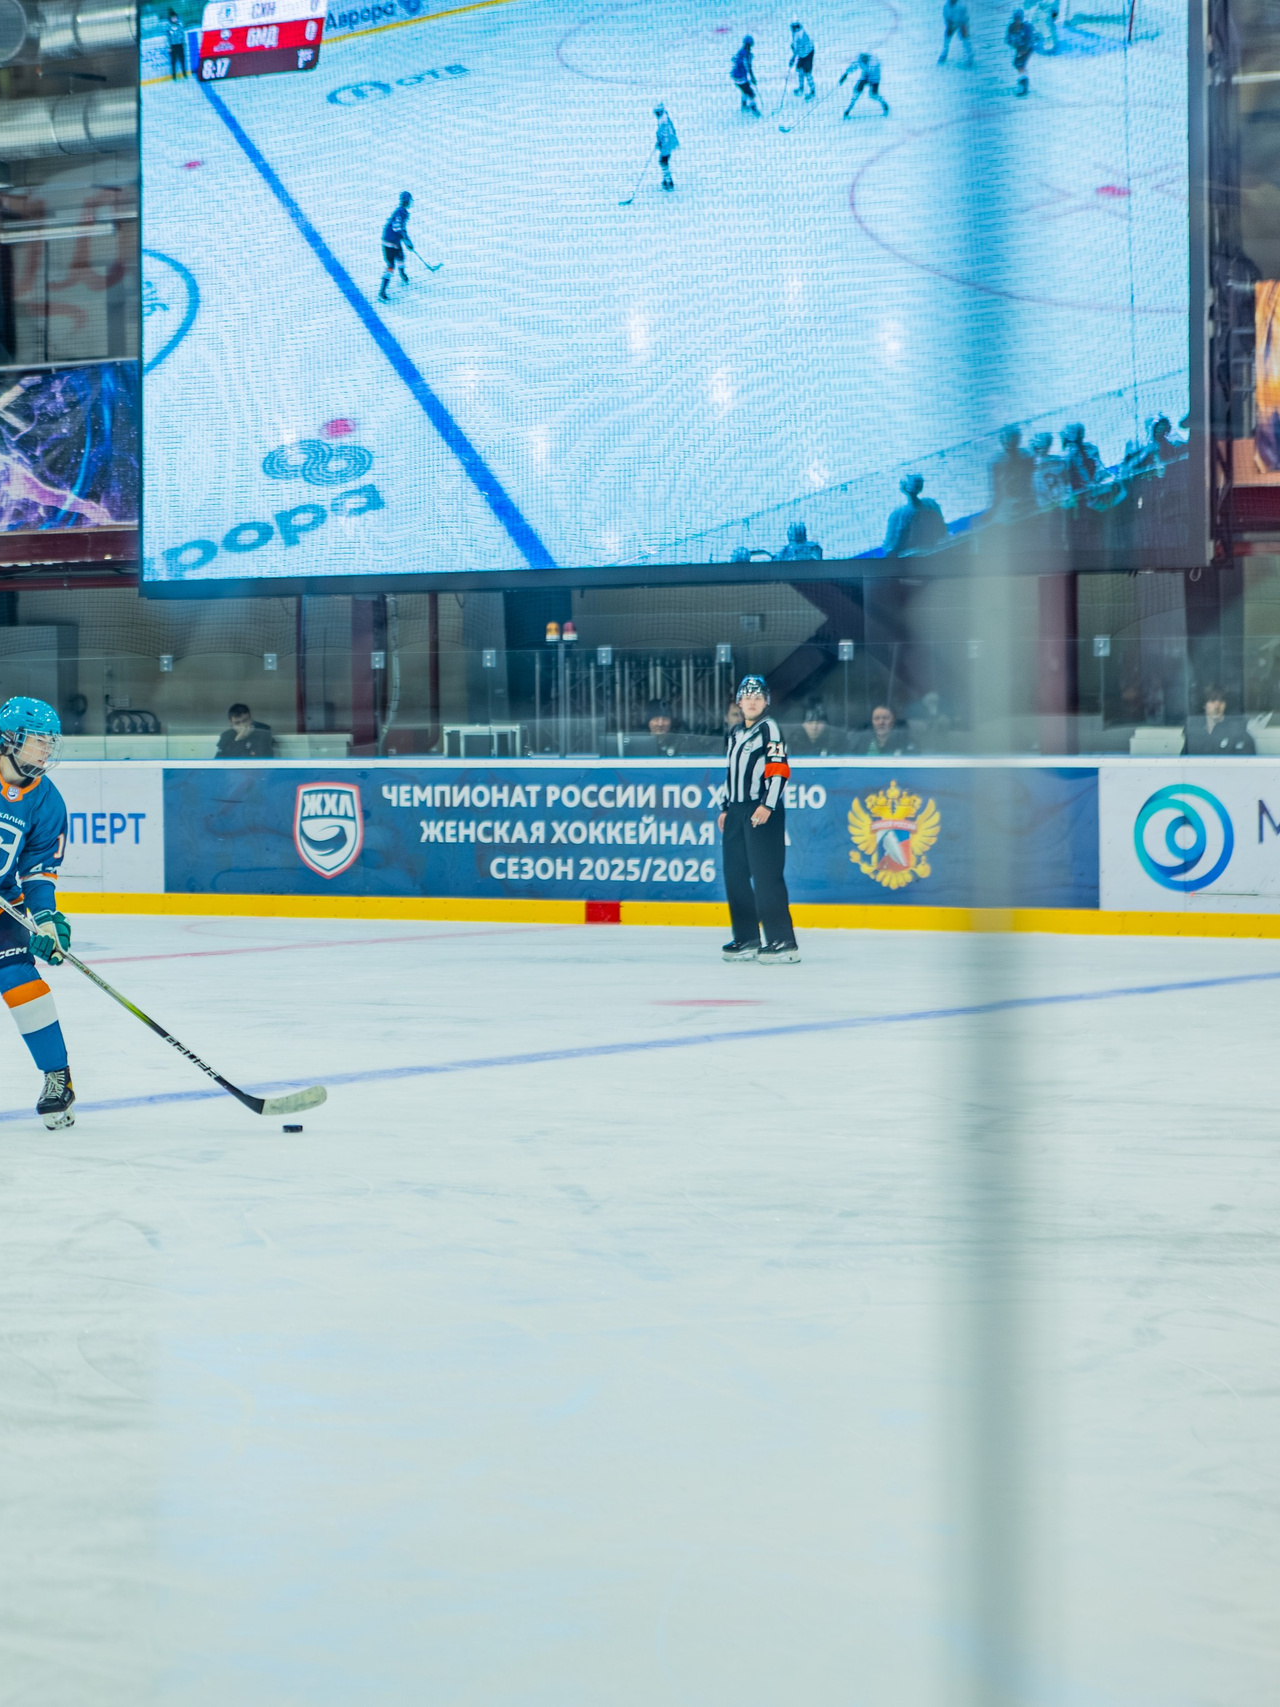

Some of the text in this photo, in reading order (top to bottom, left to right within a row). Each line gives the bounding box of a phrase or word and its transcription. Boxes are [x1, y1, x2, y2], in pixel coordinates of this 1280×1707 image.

[305, 20, 318, 41] 0
[766, 742, 786, 758] 21
[303, 794, 354, 818] ЖХЛ
[381, 784, 827, 810] ЧЕМПИОНАТ РОССИИ ПО ХЕЮ
[420, 815, 715, 846] ЖЕНСКАЯ ХОККЕЙНАЯ
[489, 857, 716, 883] СЕЗОН 2025/2026
